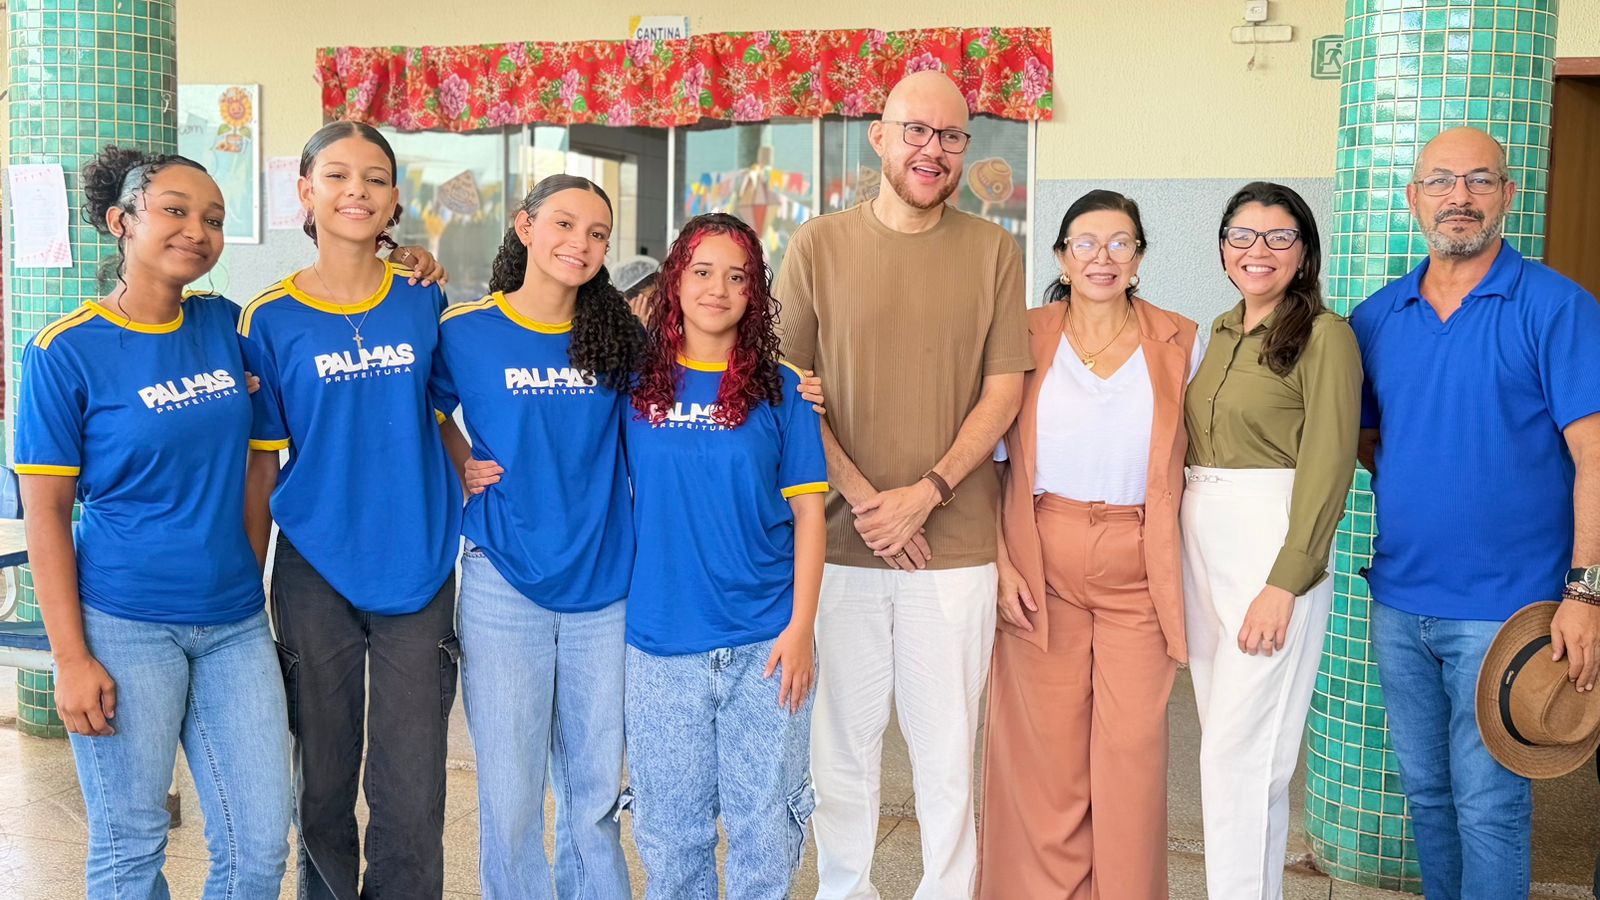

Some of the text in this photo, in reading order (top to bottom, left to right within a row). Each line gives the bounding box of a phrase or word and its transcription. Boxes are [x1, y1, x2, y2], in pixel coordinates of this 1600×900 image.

[636, 27, 681, 40] CANTINA
[314, 343, 415, 378] PALMAS
[325, 366, 412, 385] PREFEITURA
[504, 367, 598, 389] PALMAS
[137, 369, 236, 409] PALMAS
[512, 388, 595, 396] PREFEITURA
[156, 388, 239, 414] PREFEITURA
[651, 421, 734, 432] PREFEITUR
